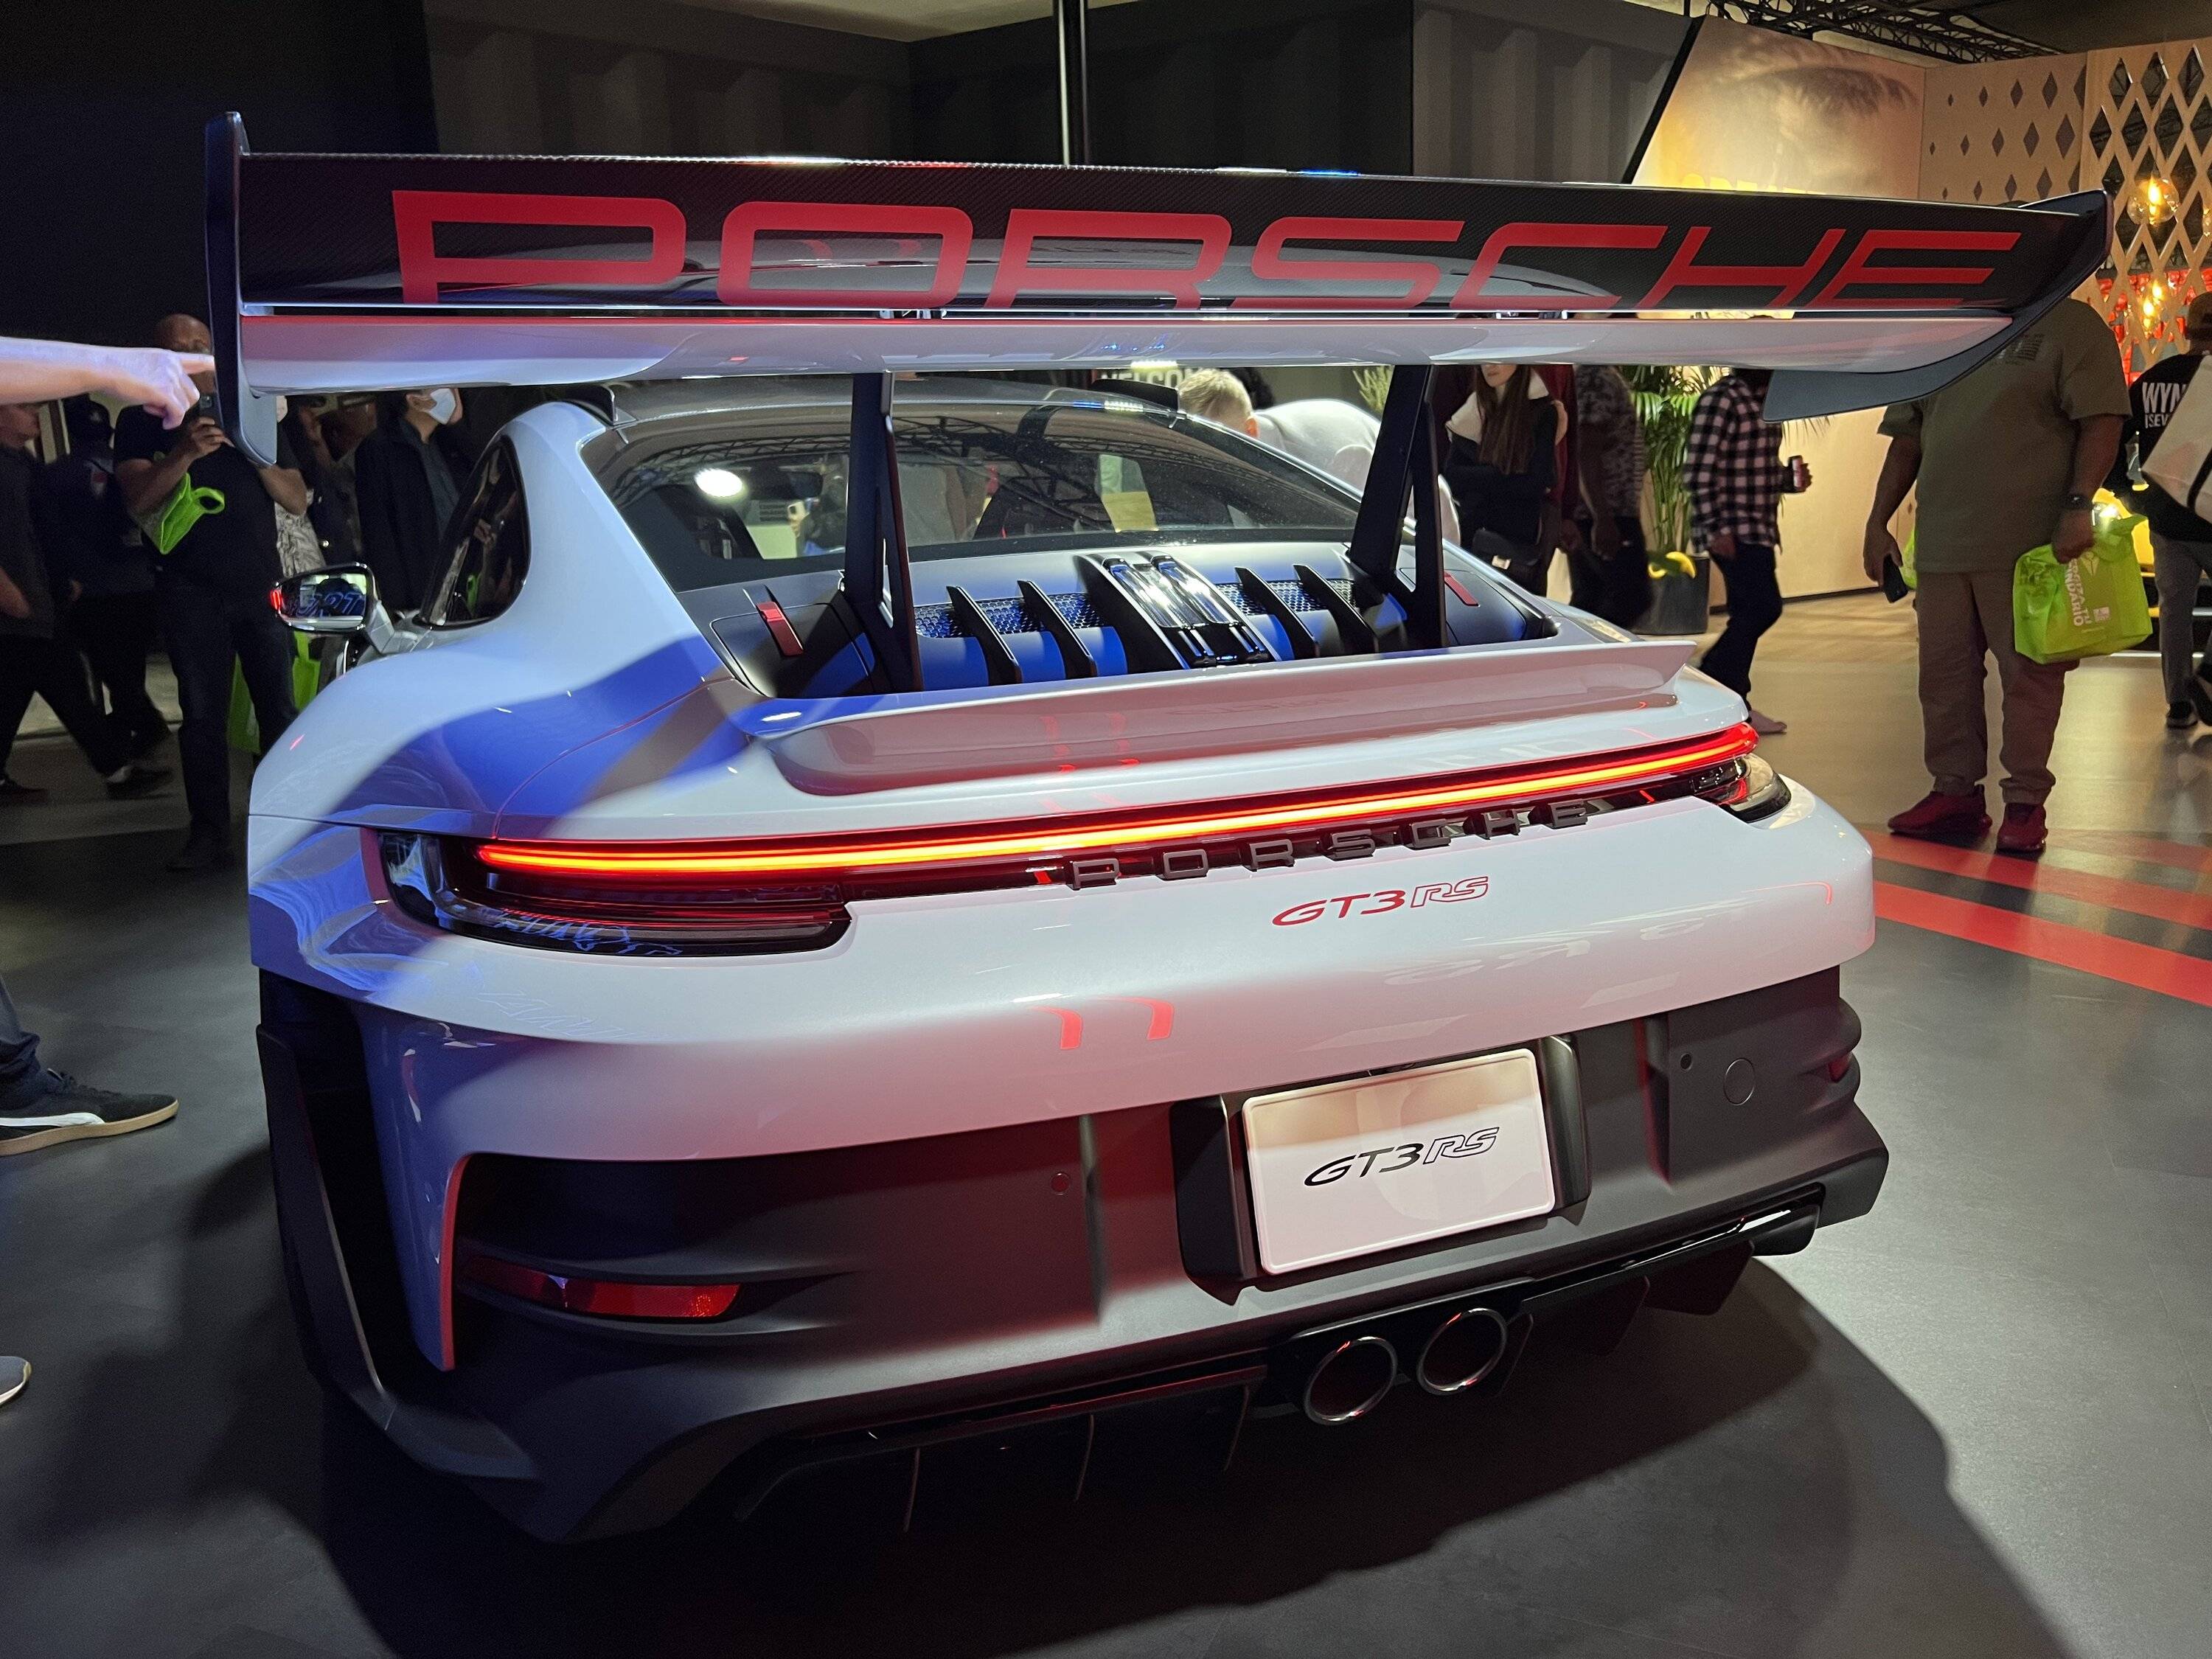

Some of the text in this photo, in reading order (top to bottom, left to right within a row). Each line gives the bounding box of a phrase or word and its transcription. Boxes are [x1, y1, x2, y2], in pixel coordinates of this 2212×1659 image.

[392, 189, 2022, 310] PORSCHE
[2142, 382, 2187, 413] WYN
[1070, 799, 1587, 889] PORSCHE
